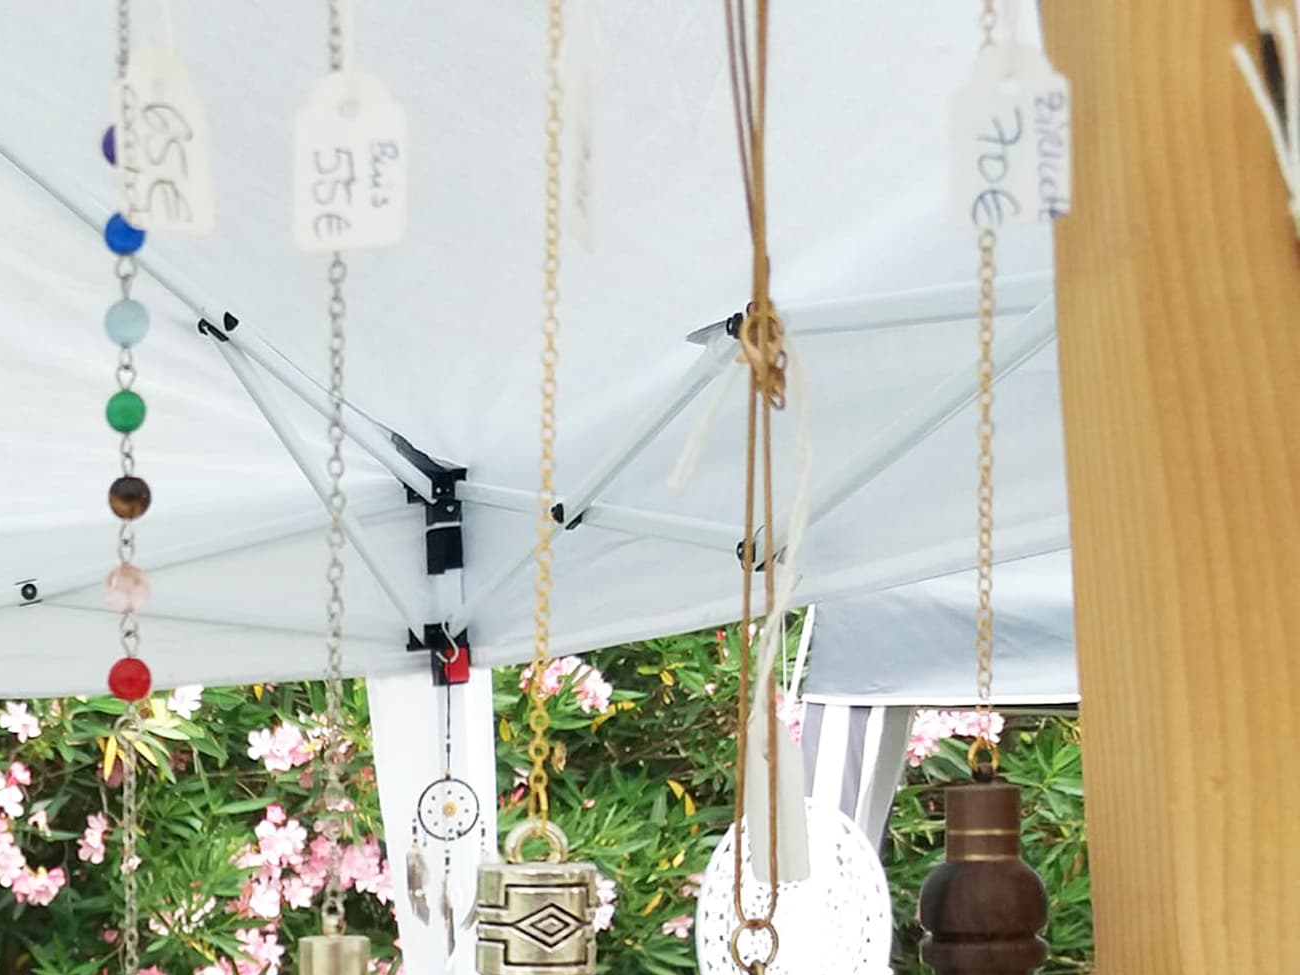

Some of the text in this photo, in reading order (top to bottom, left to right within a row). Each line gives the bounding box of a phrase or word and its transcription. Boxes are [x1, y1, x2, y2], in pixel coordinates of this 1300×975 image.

[142, 103, 194, 224] 65€
[312, 146, 356, 240] 55€
[972, 107, 1022, 226] 70€
